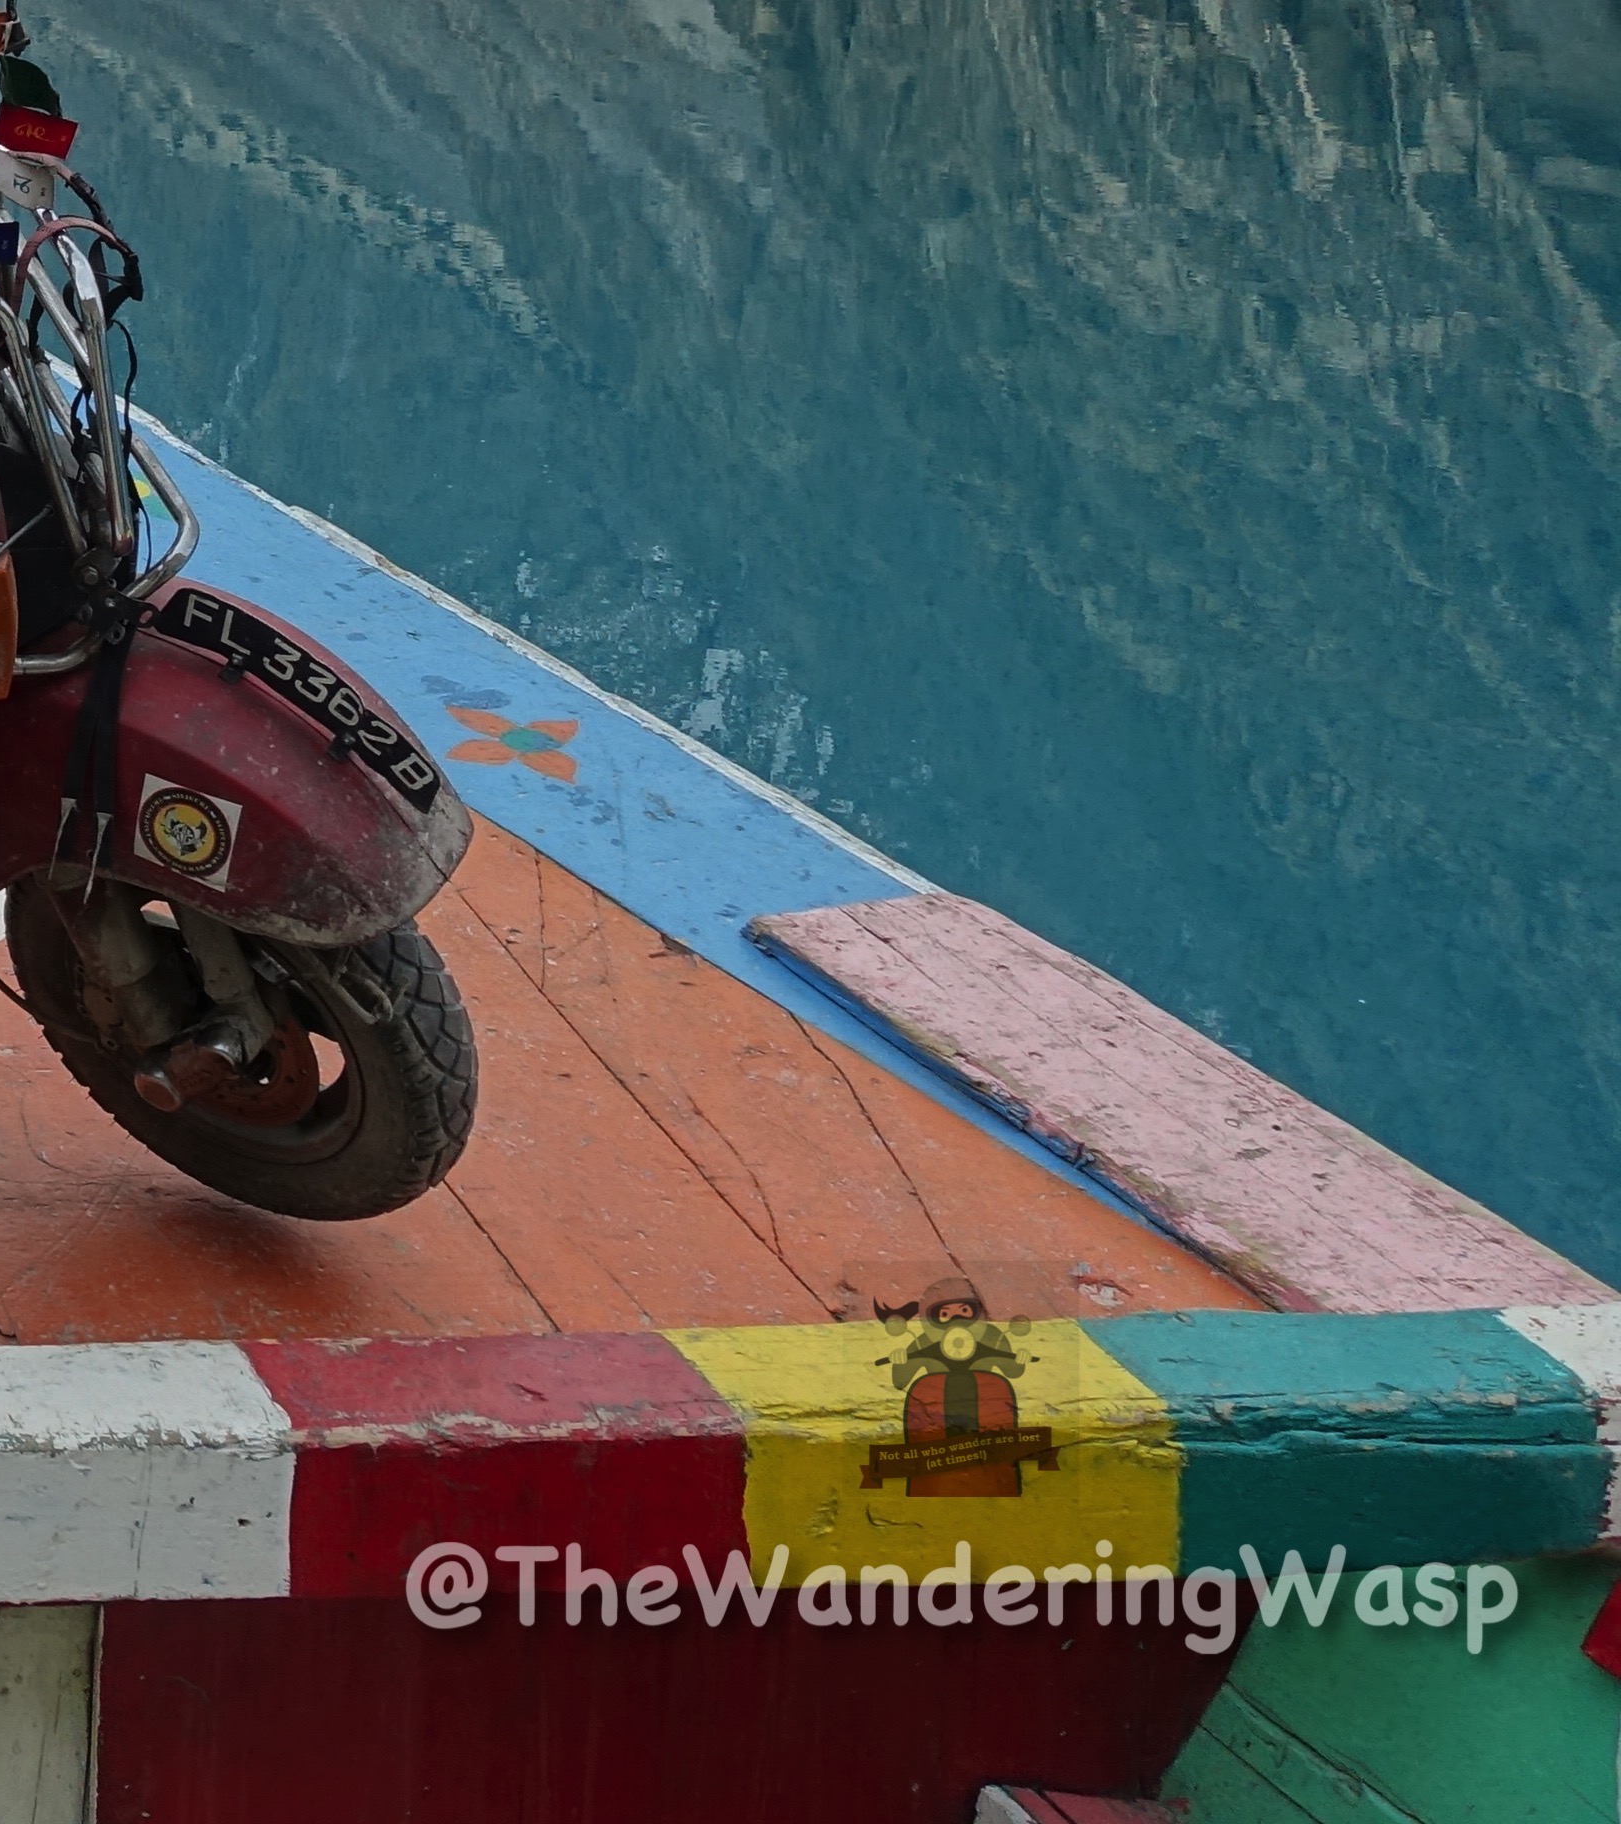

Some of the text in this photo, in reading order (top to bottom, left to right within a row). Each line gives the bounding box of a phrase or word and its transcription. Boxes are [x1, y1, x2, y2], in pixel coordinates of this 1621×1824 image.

[183, 592, 435, 791] FL 3362 B
